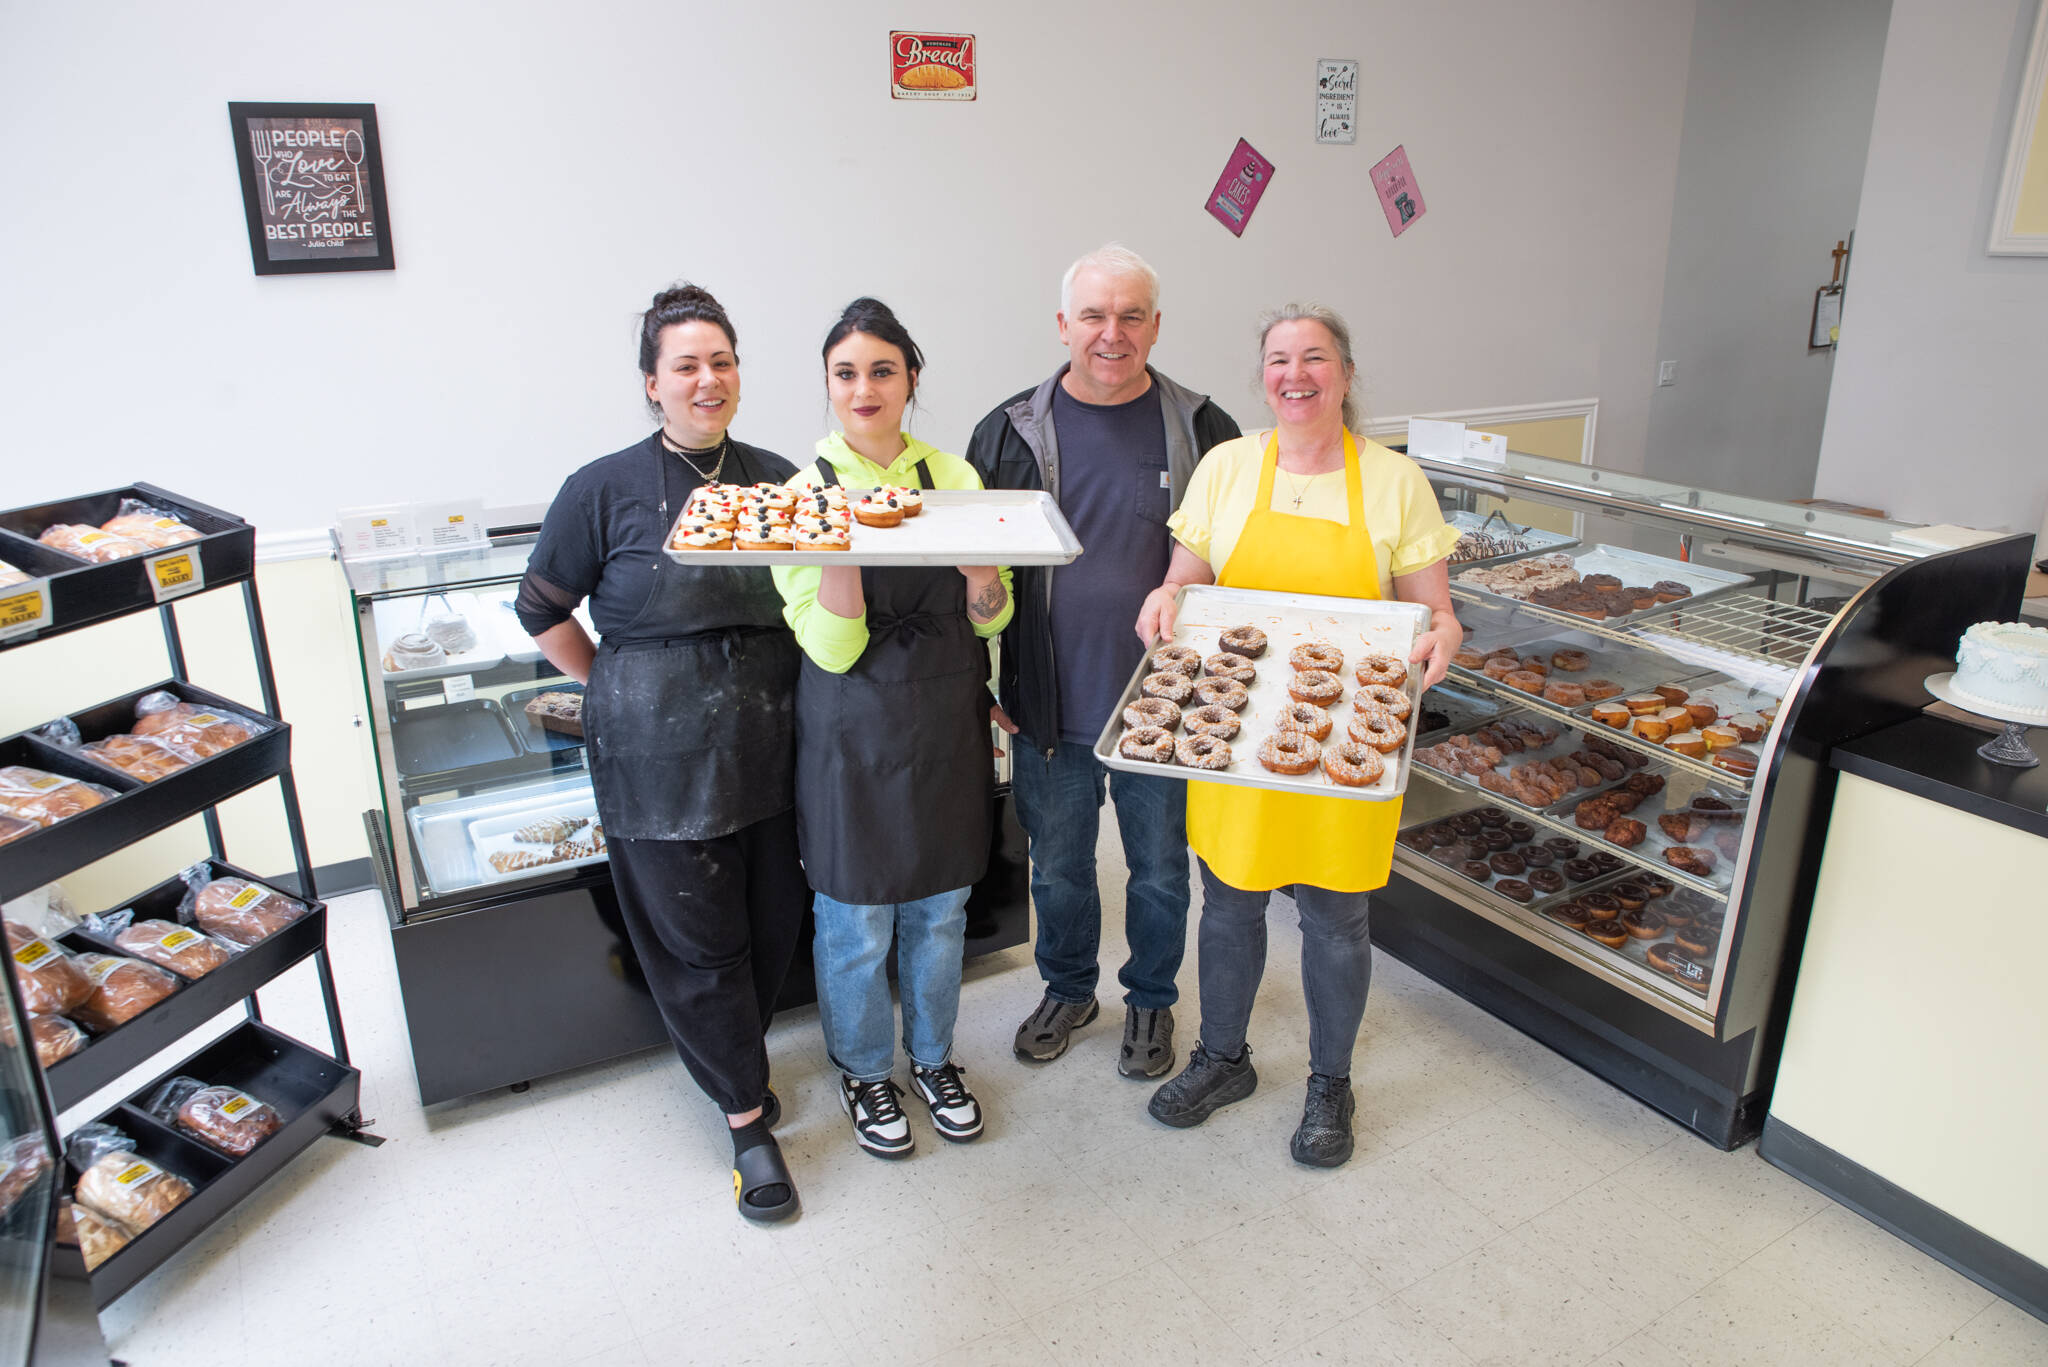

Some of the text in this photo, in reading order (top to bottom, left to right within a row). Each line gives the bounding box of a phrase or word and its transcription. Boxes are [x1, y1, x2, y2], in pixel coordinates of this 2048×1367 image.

[896, 36, 970, 70] Bread
[271, 130, 342, 147] PEOPLE
[273, 150, 293, 159] WHO
[280, 151, 344, 188] Love
[322, 173, 351, 182] TO EAT
[275, 190, 293, 198] ARE
[1228, 178, 1251, 205] CAKES
[280, 190, 351, 220] Always
[342, 210, 358, 218] THE
[265, 221, 374, 240] BEST PEOPLE
[308, 239, 345, 248] Julia Child
